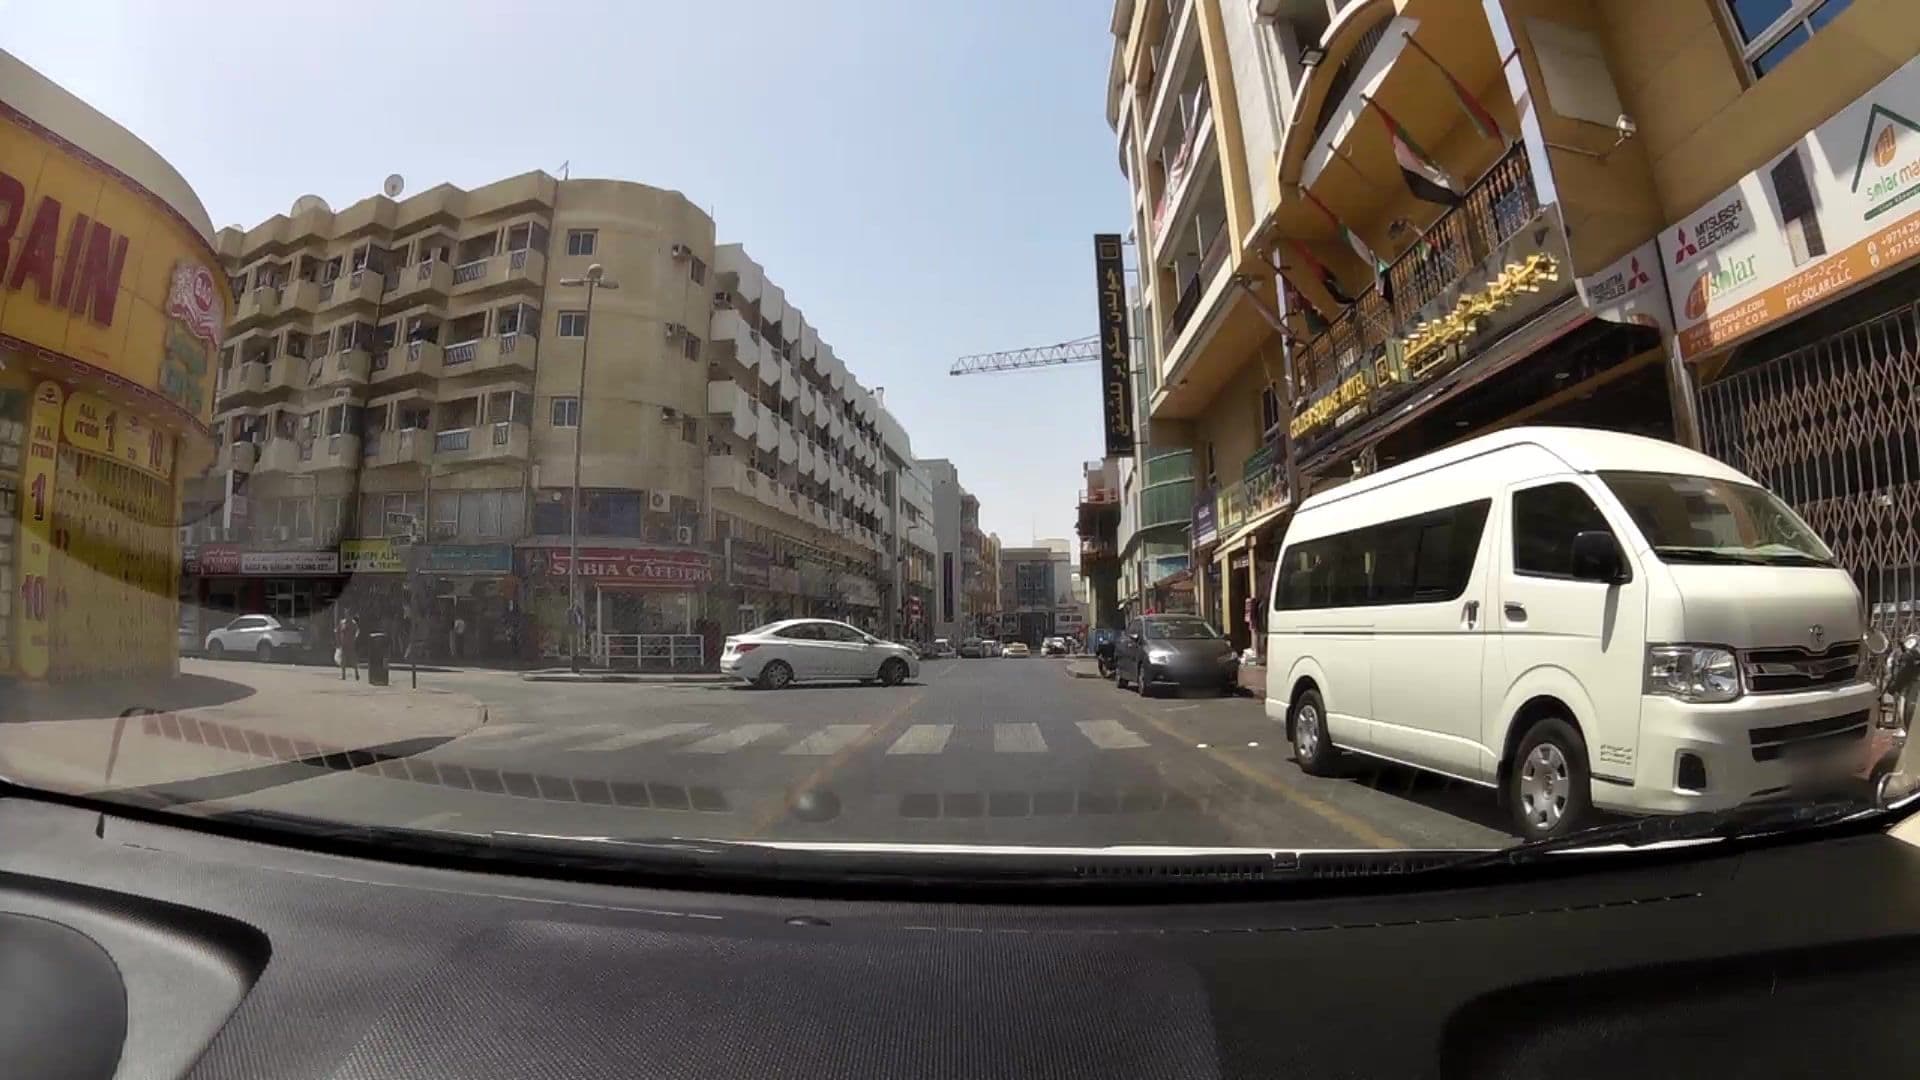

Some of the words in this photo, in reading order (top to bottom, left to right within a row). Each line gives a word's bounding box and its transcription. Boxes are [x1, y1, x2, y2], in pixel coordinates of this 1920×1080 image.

[1695, 199, 1743, 239] MITSUBISHI
[1697, 216, 1740, 251] ELECTRIC
[1711, 253, 1757, 296] solar
[552, 560, 621, 577] SABIA
[625, 561, 713, 582] CAFETERIA
